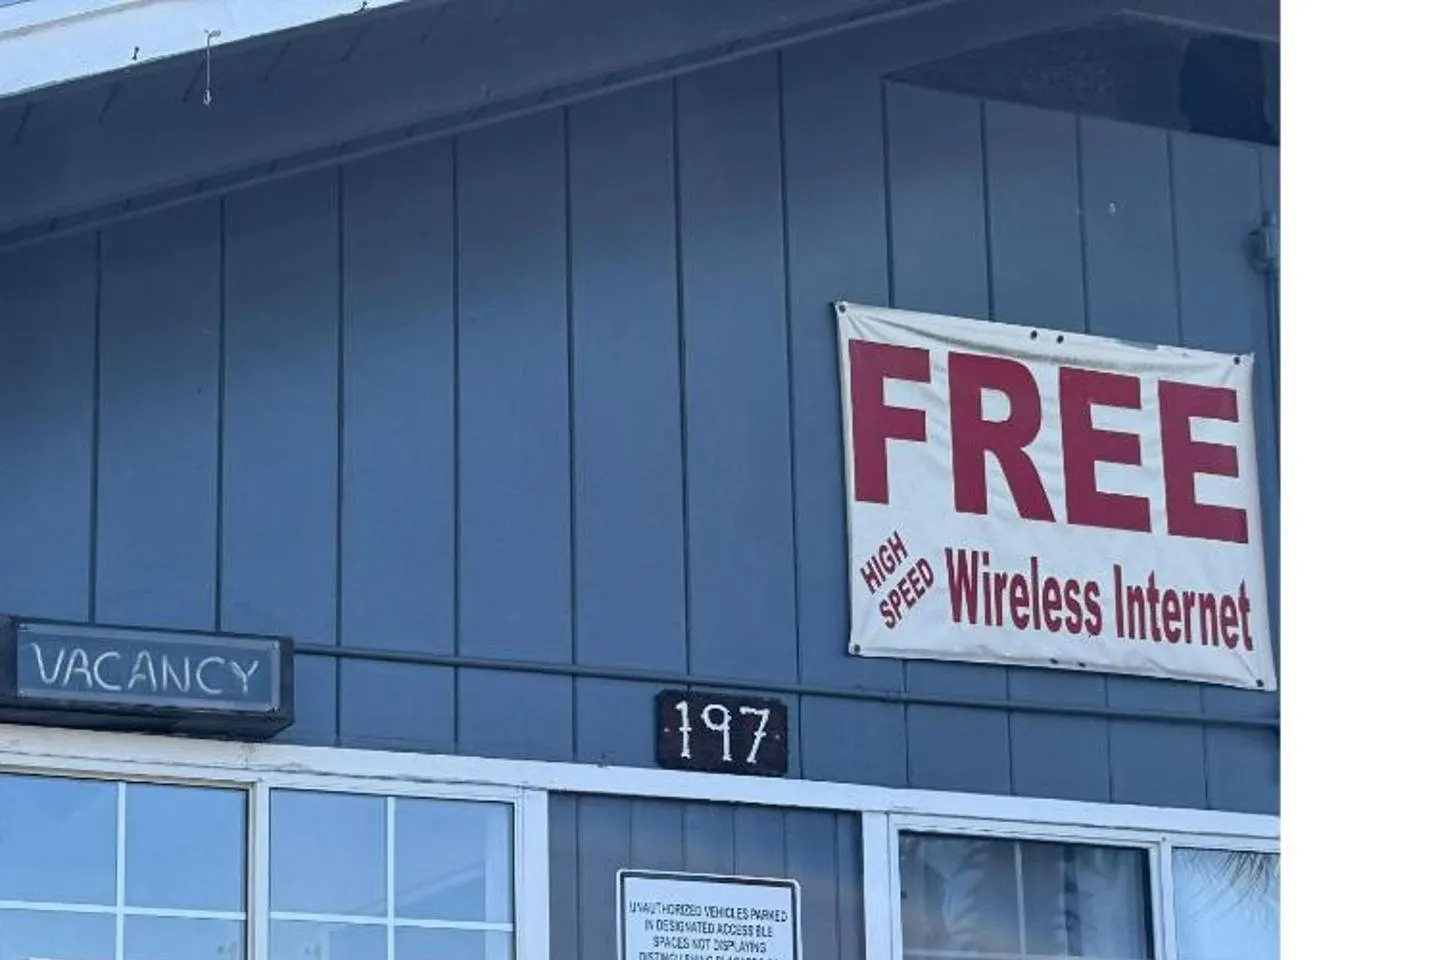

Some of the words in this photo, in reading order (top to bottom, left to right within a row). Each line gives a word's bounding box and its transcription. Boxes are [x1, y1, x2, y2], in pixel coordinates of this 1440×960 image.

[848, 339, 1249, 544] FREE
[859, 530, 909, 595] HIGH
[878, 557, 934, 629] SPEED
[944, 547, 1103, 637] Wireless
[1113, 564, 1255, 652] Internet
[30, 642, 259, 696] VACANCY
[675, 700, 770, 763] 197
[629, 901, 702, 918] UNAUTHORIZED
[704, 905, 749, 921] VEHICLES
[750, 908, 788, 923] PARKED
[644, 919, 654, 931] IN
[656, 919, 715, 934] DESIGNATED
[653, 937, 690, 949] SPACES
[692, 939, 710, 951] NOT
[714, 940, 767, 954] DISPLAYING
